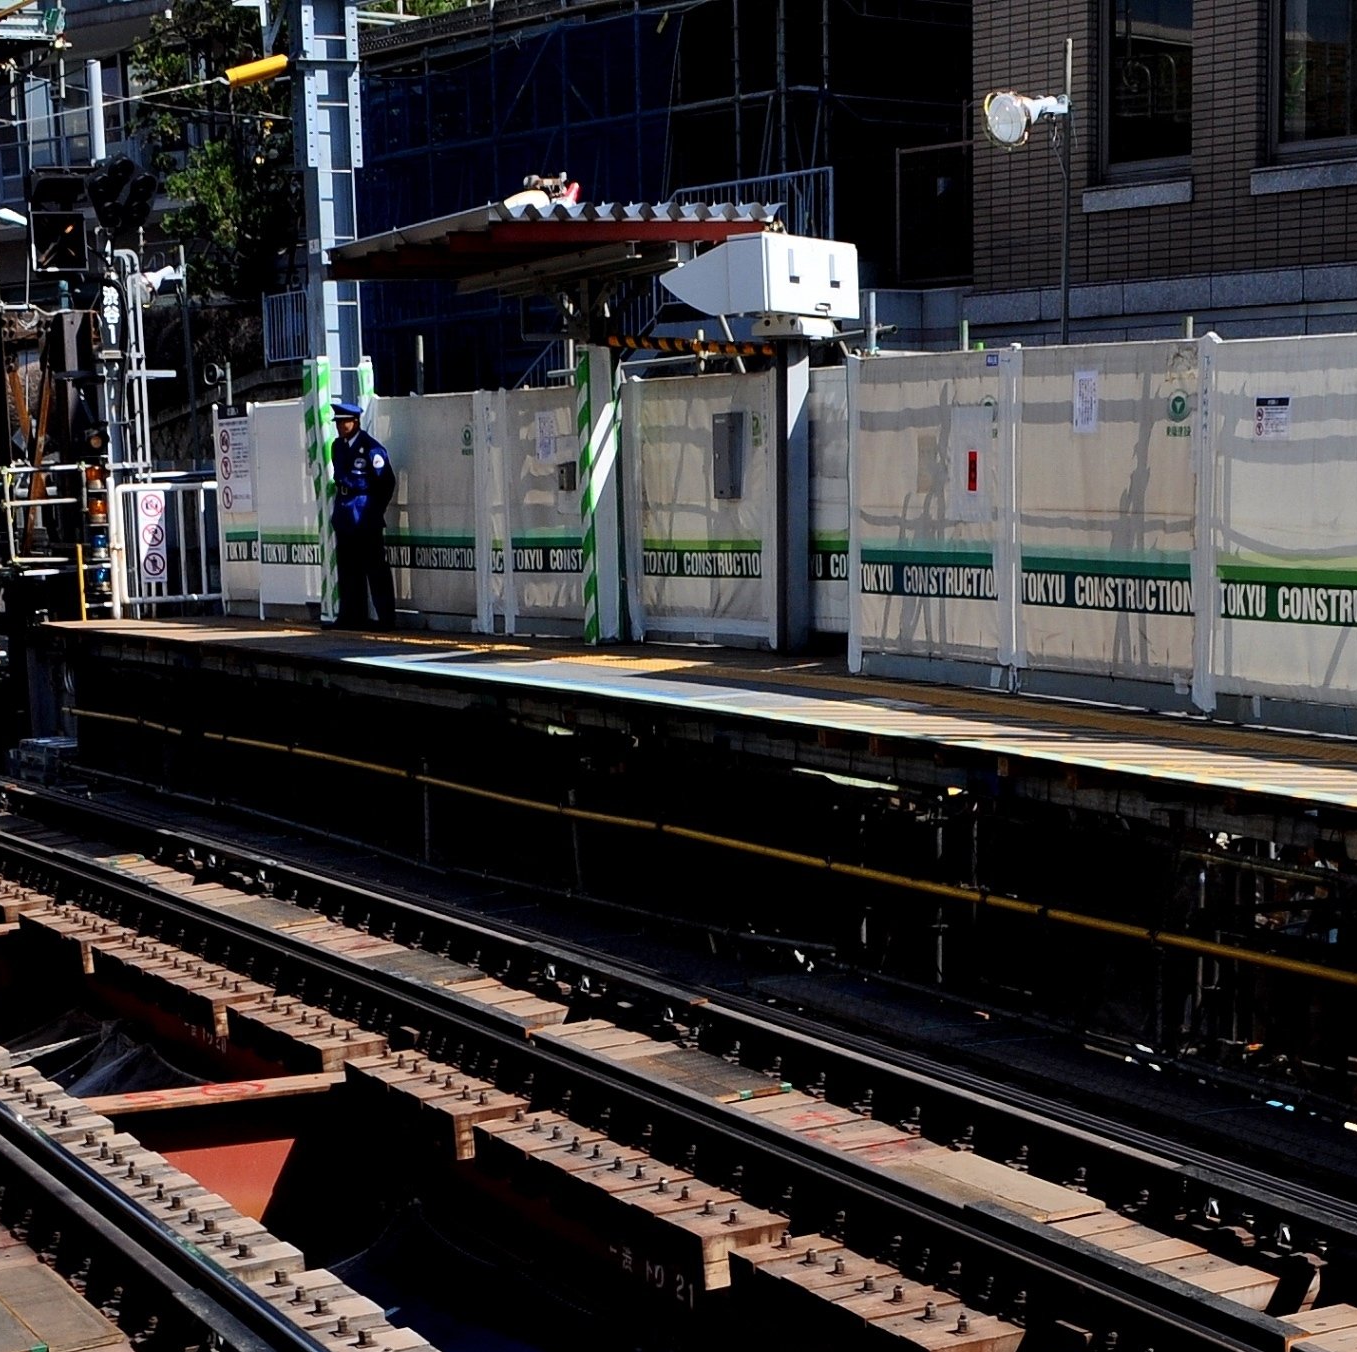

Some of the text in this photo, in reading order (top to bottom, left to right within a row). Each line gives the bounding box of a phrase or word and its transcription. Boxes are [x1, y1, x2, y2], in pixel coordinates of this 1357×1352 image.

[263, 543, 288, 563] TOKYU
[415, 547, 476, 570] CONSTRUCTIO
[644, 551, 678, 574] TOKYU
[830, 554, 848, 579] CO
[903, 565, 997, 599] CONSTRUCTIO
[1021, 572, 1193, 614] TOKYU CONSTRUCTION
[1220, 583, 1267, 617] TOKYU
